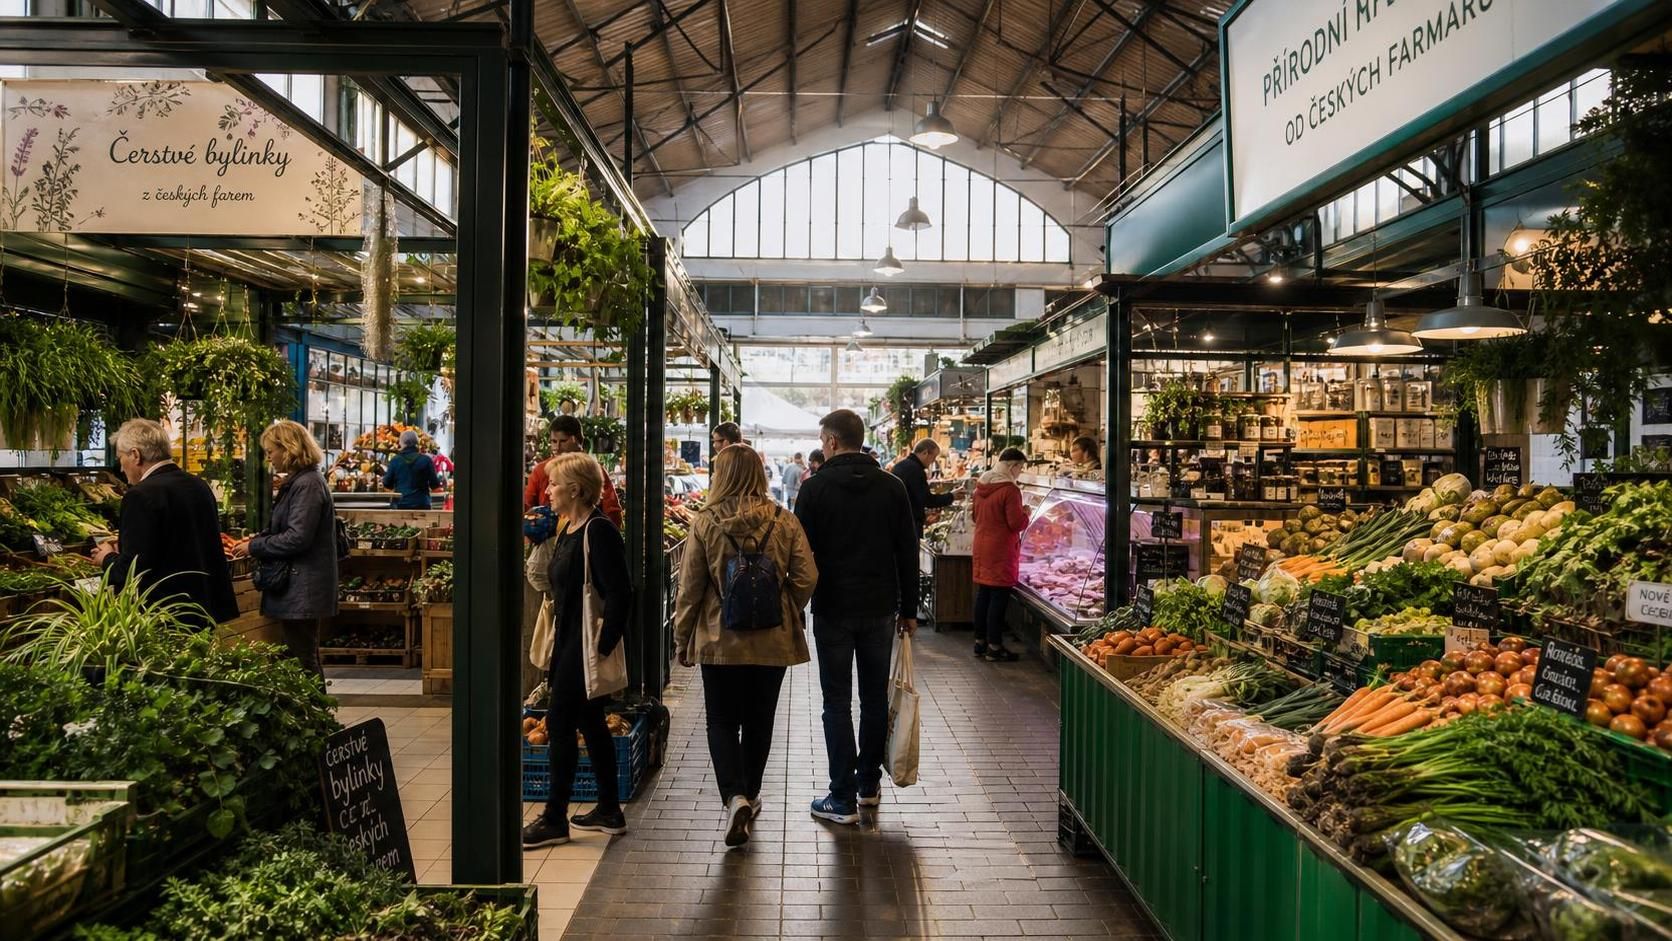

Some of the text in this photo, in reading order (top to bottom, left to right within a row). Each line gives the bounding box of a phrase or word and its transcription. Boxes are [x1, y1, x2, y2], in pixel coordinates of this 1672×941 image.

[1263, 0, 1347, 107] PŘÍRODNÍ
[1285, 113, 1304, 146] OD
[1309, 56, 1380, 130] ČESKÝCH
[109, 129, 292, 178] Čerstvé bylinky
[142, 184, 255, 208] z českých farem
[329, 754, 384, 807] bylinky
